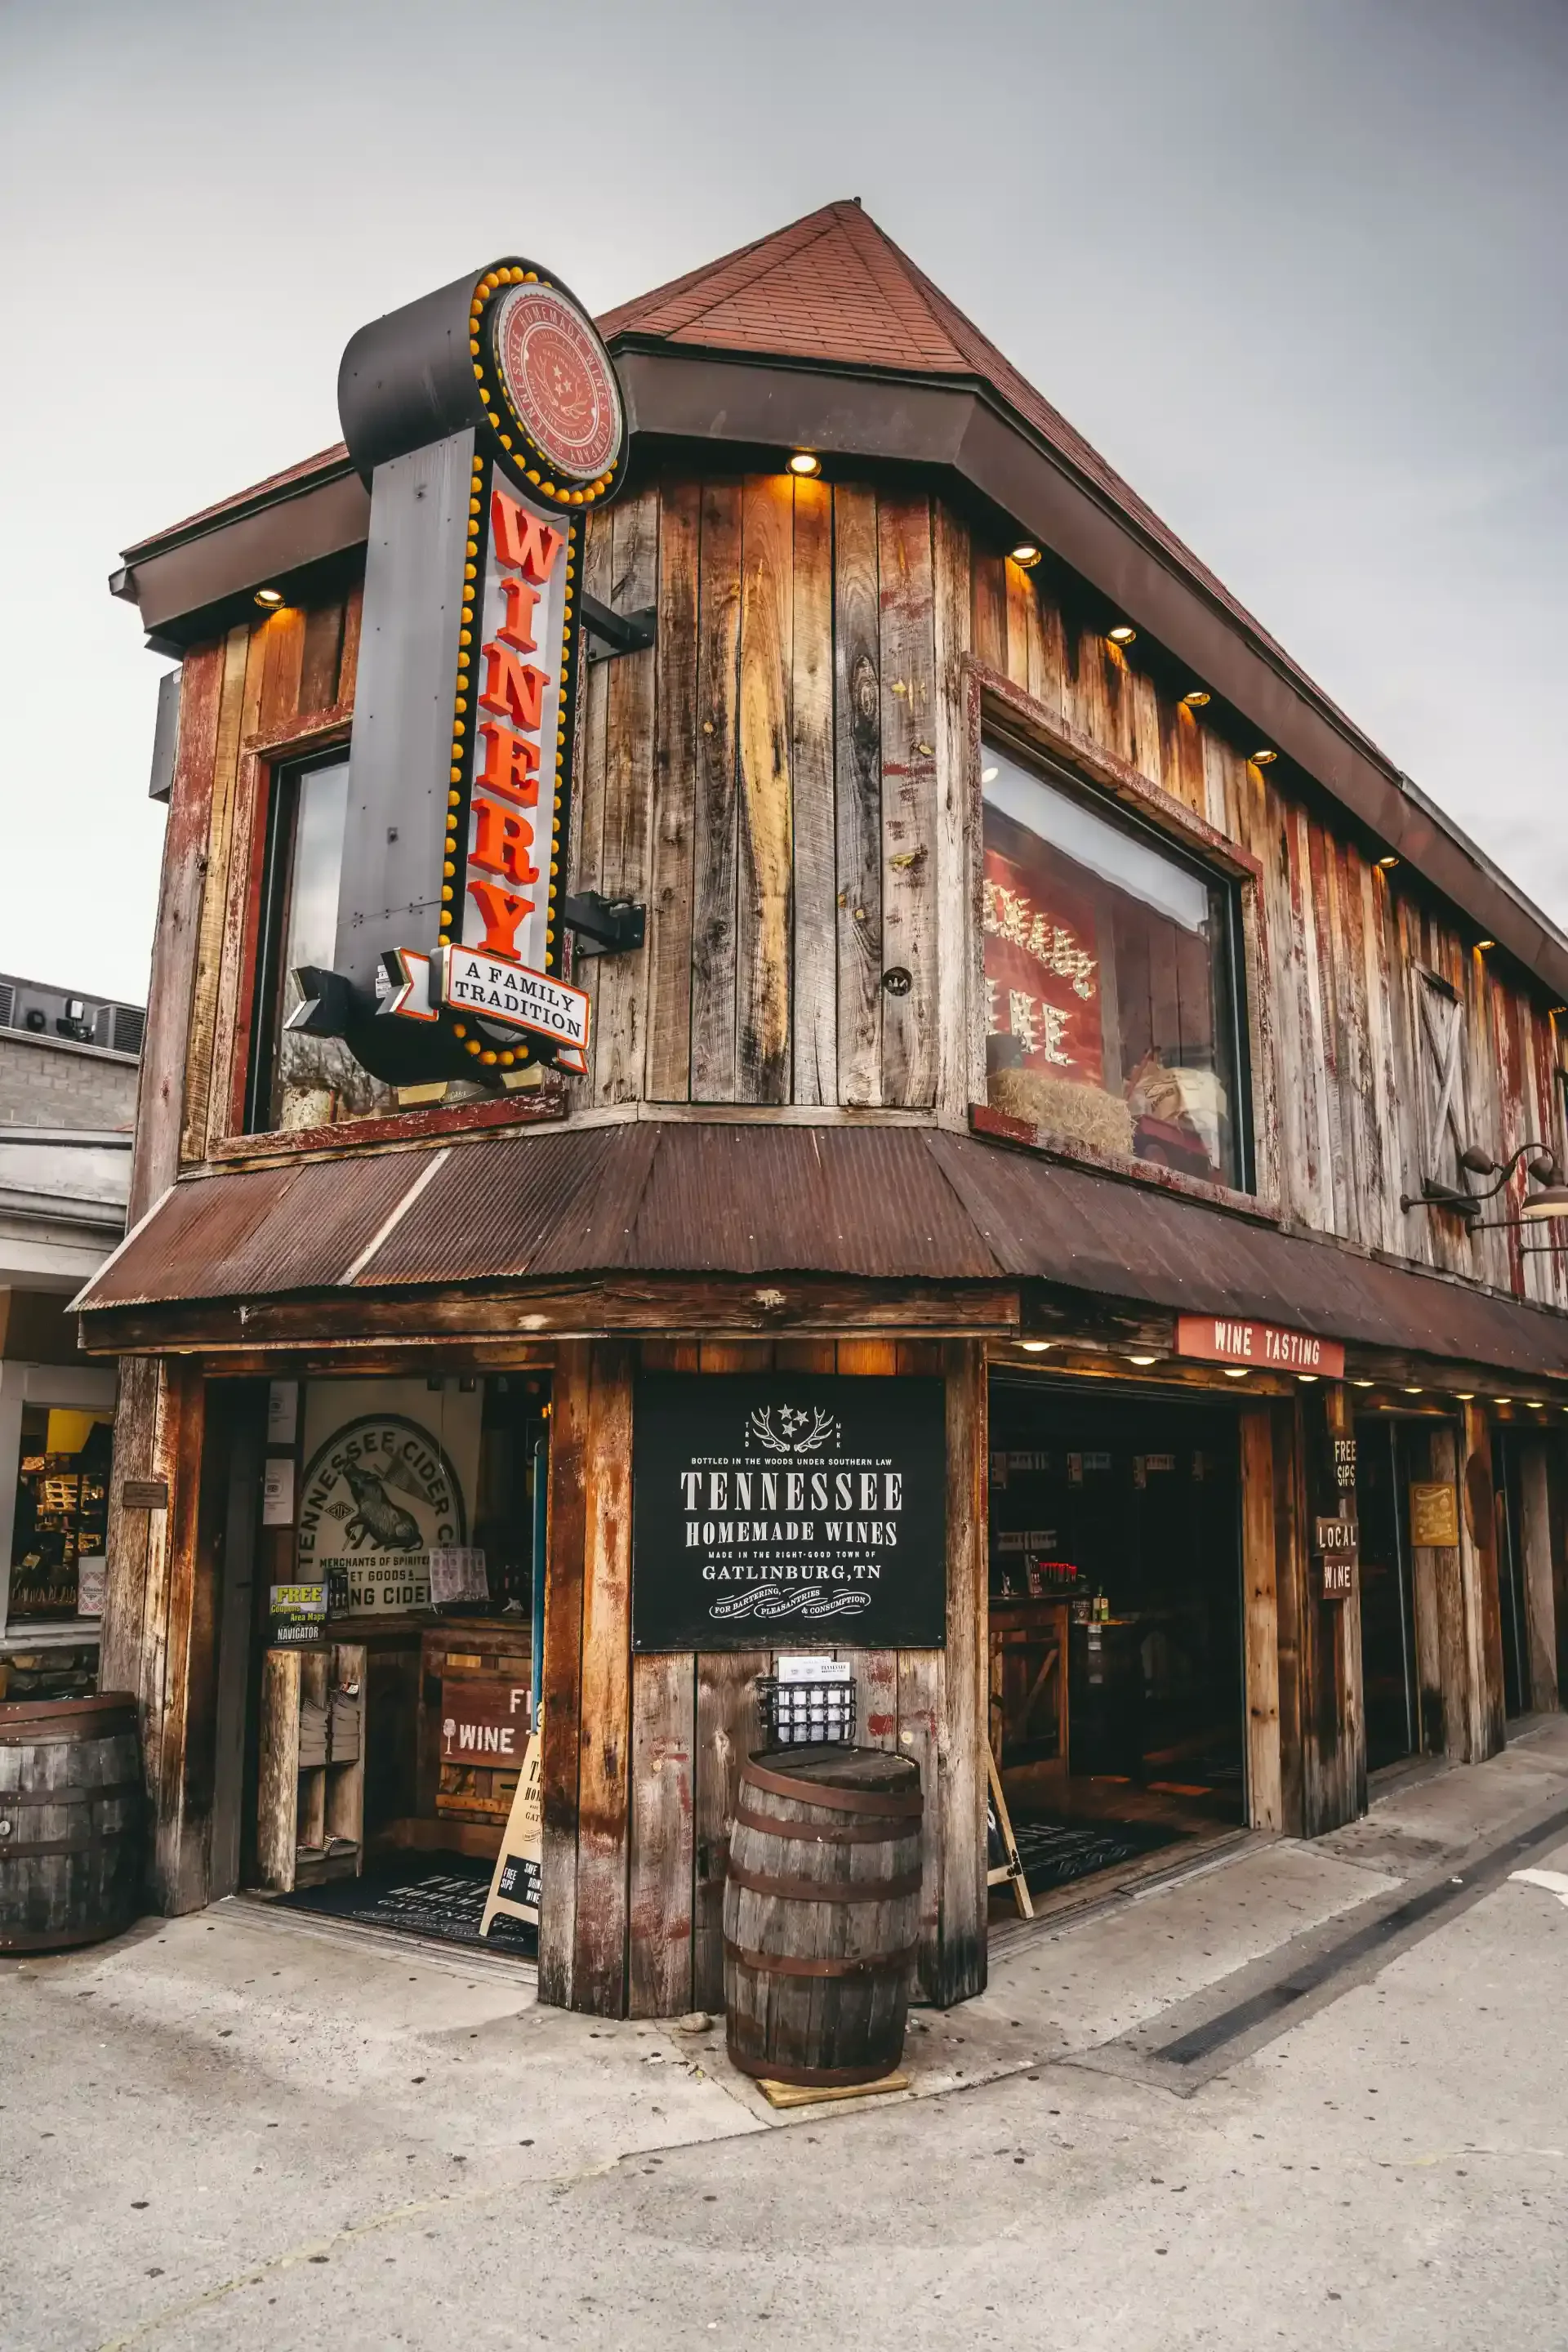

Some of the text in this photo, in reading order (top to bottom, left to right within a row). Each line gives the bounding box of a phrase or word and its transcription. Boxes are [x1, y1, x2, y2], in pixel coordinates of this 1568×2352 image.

[519, 306, 583, 345] HOMEMADE
[510, 329, 549, 441] TENNESSEE
[586, 352, 609, 413] WINES
[569, 421, 609, 464] COMPANY
[467, 489, 565, 961] WINERY
[465, 962, 574, 1013] A FAMILY
[455, 981, 581, 1038] TRADITION
[1214, 1321, 1320, 1365] WINE TASTING
[691, 1457, 893, 1468] BOTTLED IN THE WOODS UNDER SOUTHERN LAW
[1334, 1440, 1356, 1463] FREE
[1337, 1464, 1356, 1487] SIPS
[297, 1431, 397, 1569] TENNESSEE
[403, 1440, 450, 1517] CIDER
[680, 1472, 902, 1512] TENNESSEE
[685, 1521, 898, 1548] HOMEMADE WINES
[1319, 1525, 1356, 1548] LOCAL
[319, 1557, 376, 1568] MERCHANTS
[379, 1557, 390, 1567] OF
[708, 1551, 733, 1559] MADE
[738, 1551, 748, 1559] IN
[753, 1551, 771, 1559] THE
[836, 1551, 860, 1559] TOWN
[865, 1551, 876, 1559] OF
[368, 1569, 407, 1582] GOODS
[1325, 1565, 1352, 1590] WINE
[276, 1587, 323, 1604] FREE
[715, 1588, 782, 1615] FOR BARTERING,
[760, 1589, 821, 1615] PLEASANTRIES
[801, 1595, 866, 1615] & CONSUMPTION
[270, 1604, 301, 1615] Coupons
[290, 1612, 325, 1624] Area Maps
[277, 1626, 319, 1641] NAVIGATOR
[459, 1724, 515, 1755] WINE
[503, 1867, 518, 1881] FREE
[523, 1863, 537, 1876] SAVE
[501, 1878, 514, 1891] SIPS
